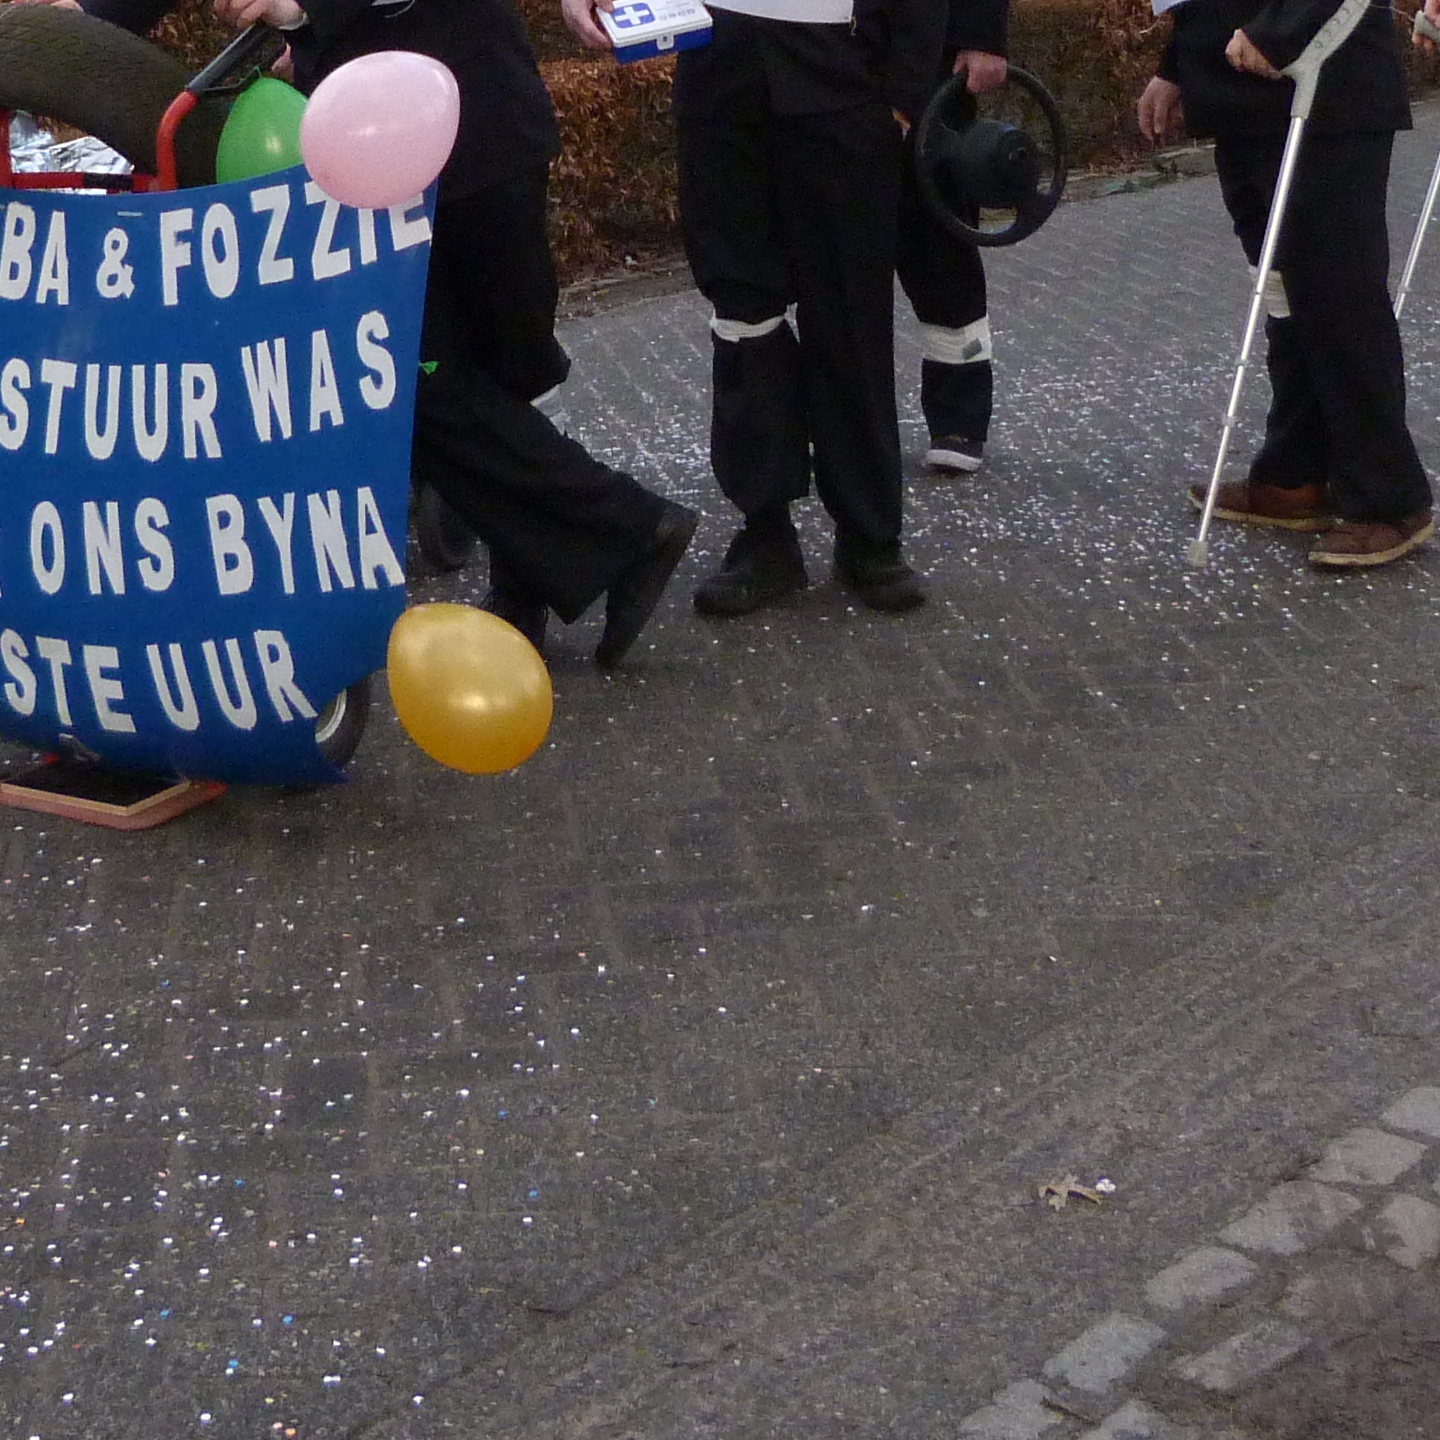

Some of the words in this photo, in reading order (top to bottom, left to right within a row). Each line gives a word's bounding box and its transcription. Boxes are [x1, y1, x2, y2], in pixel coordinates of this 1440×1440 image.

[96, 227, 135, 300] &
[160, 180, 433, 307] FOZZIE
[241, 310, 398, 443] WAS
[30, 497, 175, 596] ONS
[205, 485, 406, 596] BYNA
[146, 629, 319, 732] UUR
